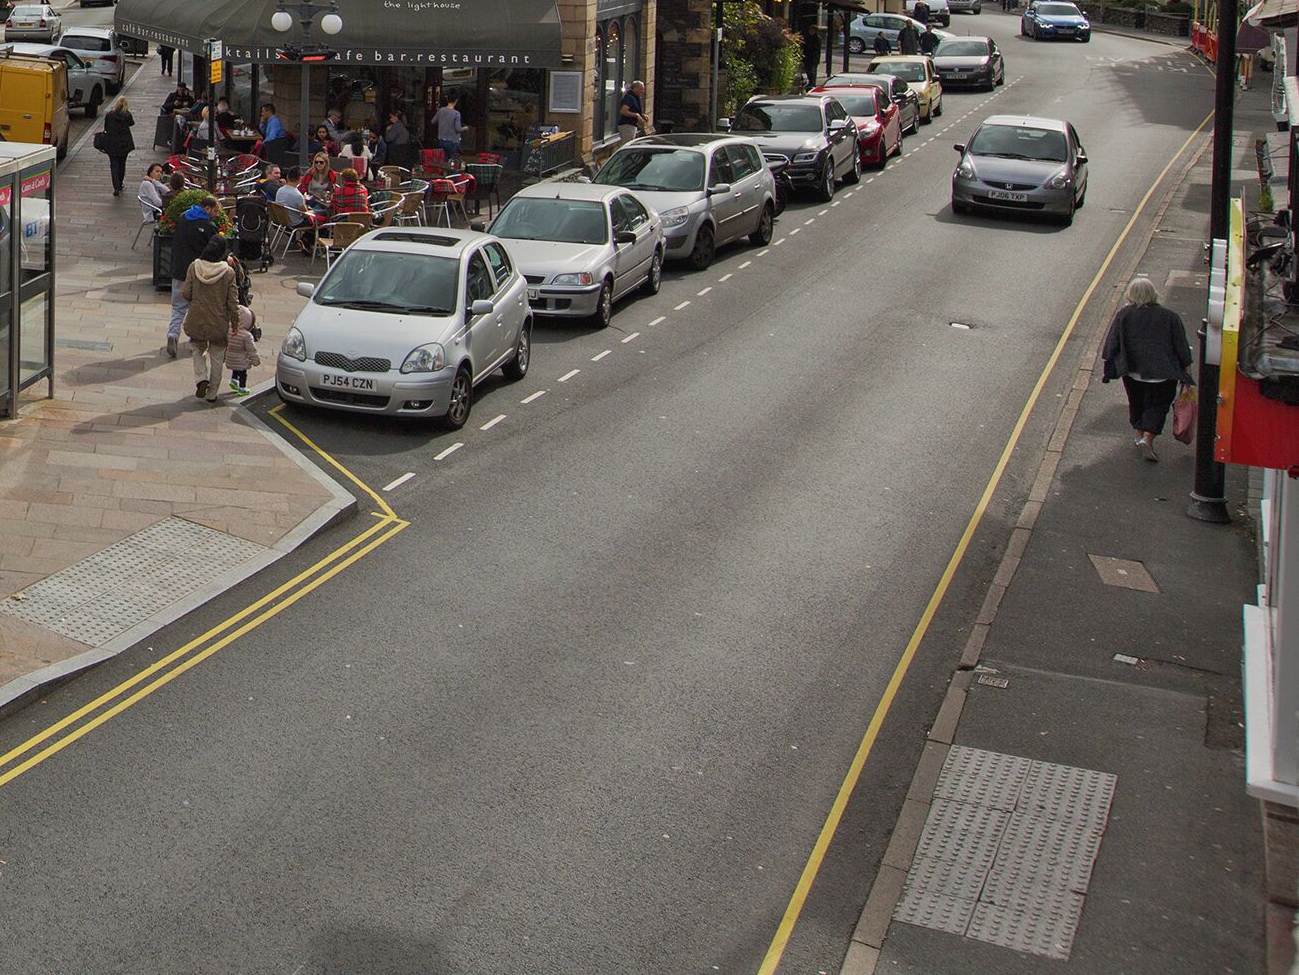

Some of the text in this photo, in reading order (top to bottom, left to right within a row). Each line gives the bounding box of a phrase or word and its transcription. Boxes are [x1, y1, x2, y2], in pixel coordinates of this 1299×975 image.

[384, 0, 461, 12] the lighthouse
[137, 27, 189, 47] bar.restaurant
[334, 49, 363, 61] afe
[374, 50, 530, 64] bar.restaurant
[26, 221, 38, 238] BT
[323, 374, 373, 390] PJ54 CZN
